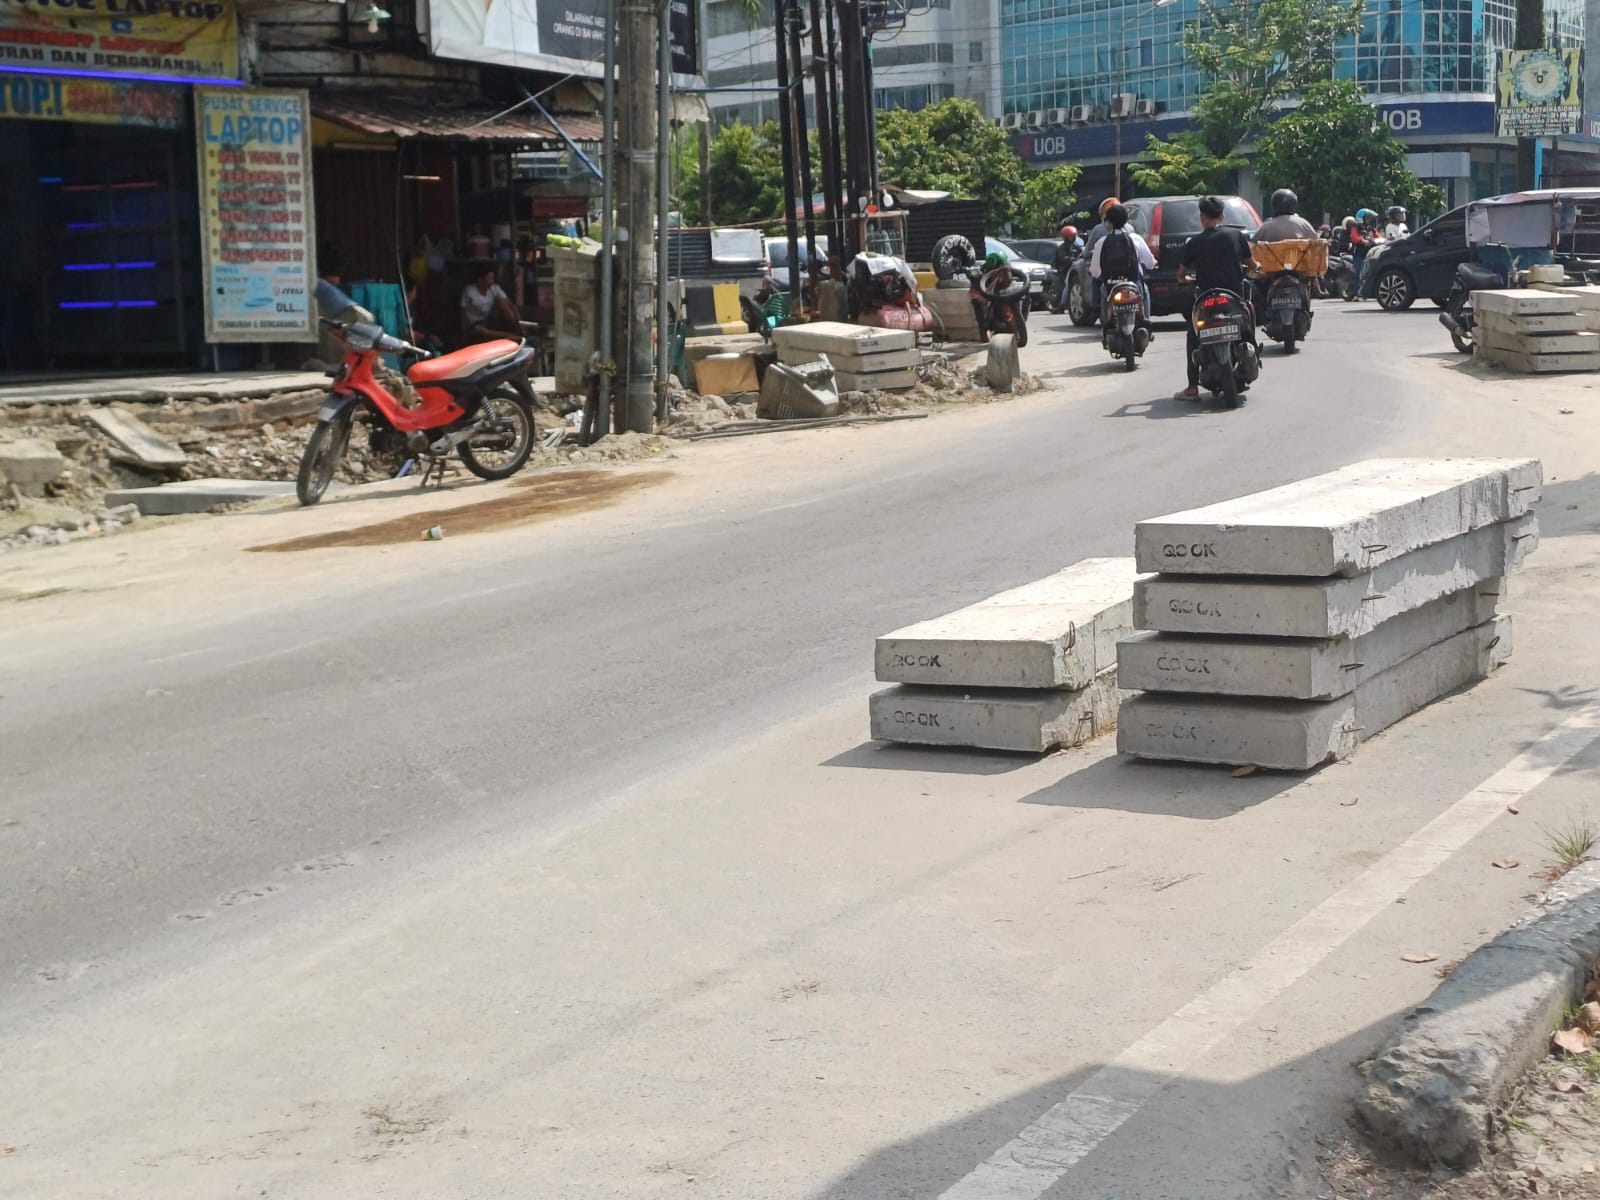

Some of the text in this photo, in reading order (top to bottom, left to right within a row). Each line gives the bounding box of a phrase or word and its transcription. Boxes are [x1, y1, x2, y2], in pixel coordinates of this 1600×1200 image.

[51, 49, 87, 62] DAN
[203, 96, 243, 110] PUSAT
[205, 114, 302, 145] LAPTOP
[1034, 136, 1066, 156] UOB
